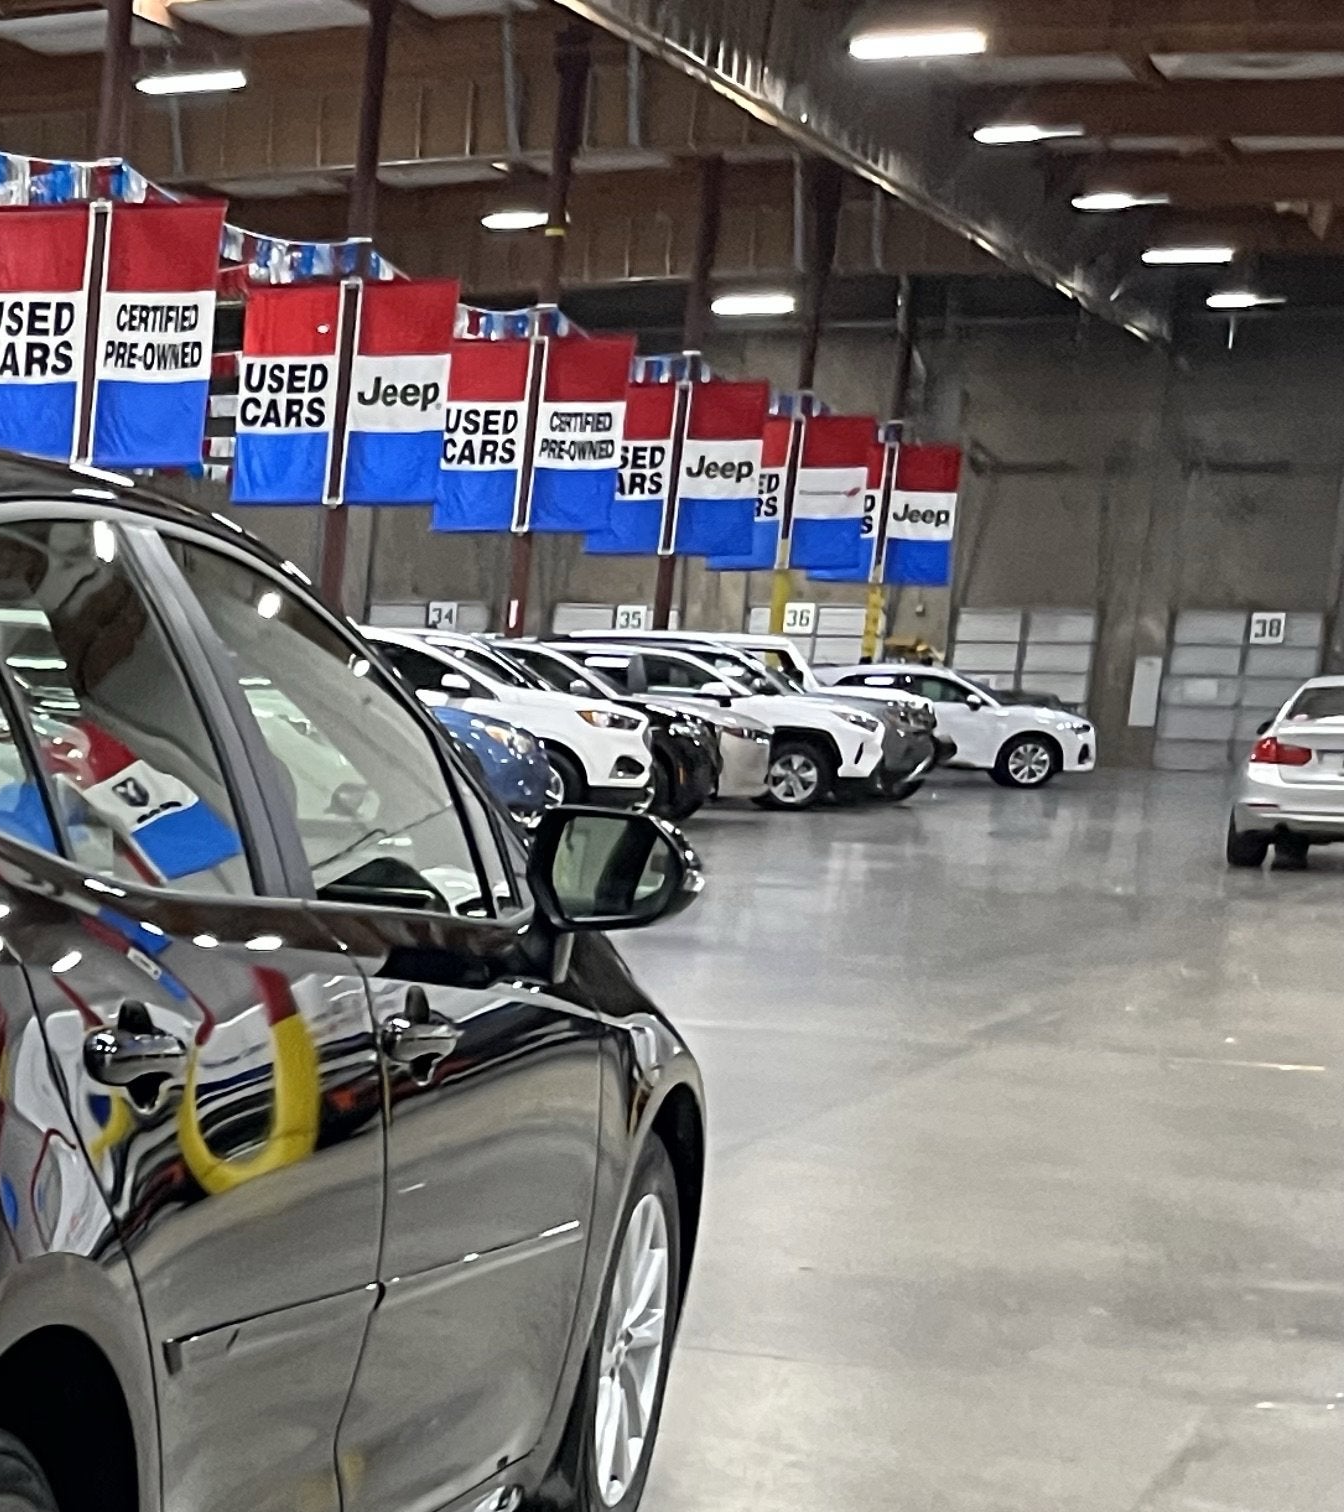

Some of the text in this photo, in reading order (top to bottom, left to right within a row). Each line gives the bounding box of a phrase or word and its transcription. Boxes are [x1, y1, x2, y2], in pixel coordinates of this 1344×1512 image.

[116, 303, 198, 332] CERTIFIED
[103, 340, 202, 371] PRE-OWNED
[244, 363, 328, 394] USED
[357, 376, 440, 412] Jeep
[240, 397, 326, 428] CARS
[446, 408, 518, 435] USED
[443, 438, 516, 465] CARS
[686, 455, 754, 483] Jeep
[893, 503, 950, 528] Jeep
[432, 607, 453, 625] 34
[619, 611, 642, 629] 35
[787, 609, 810, 627] 36
[1254, 618, 1282, 638] 38
